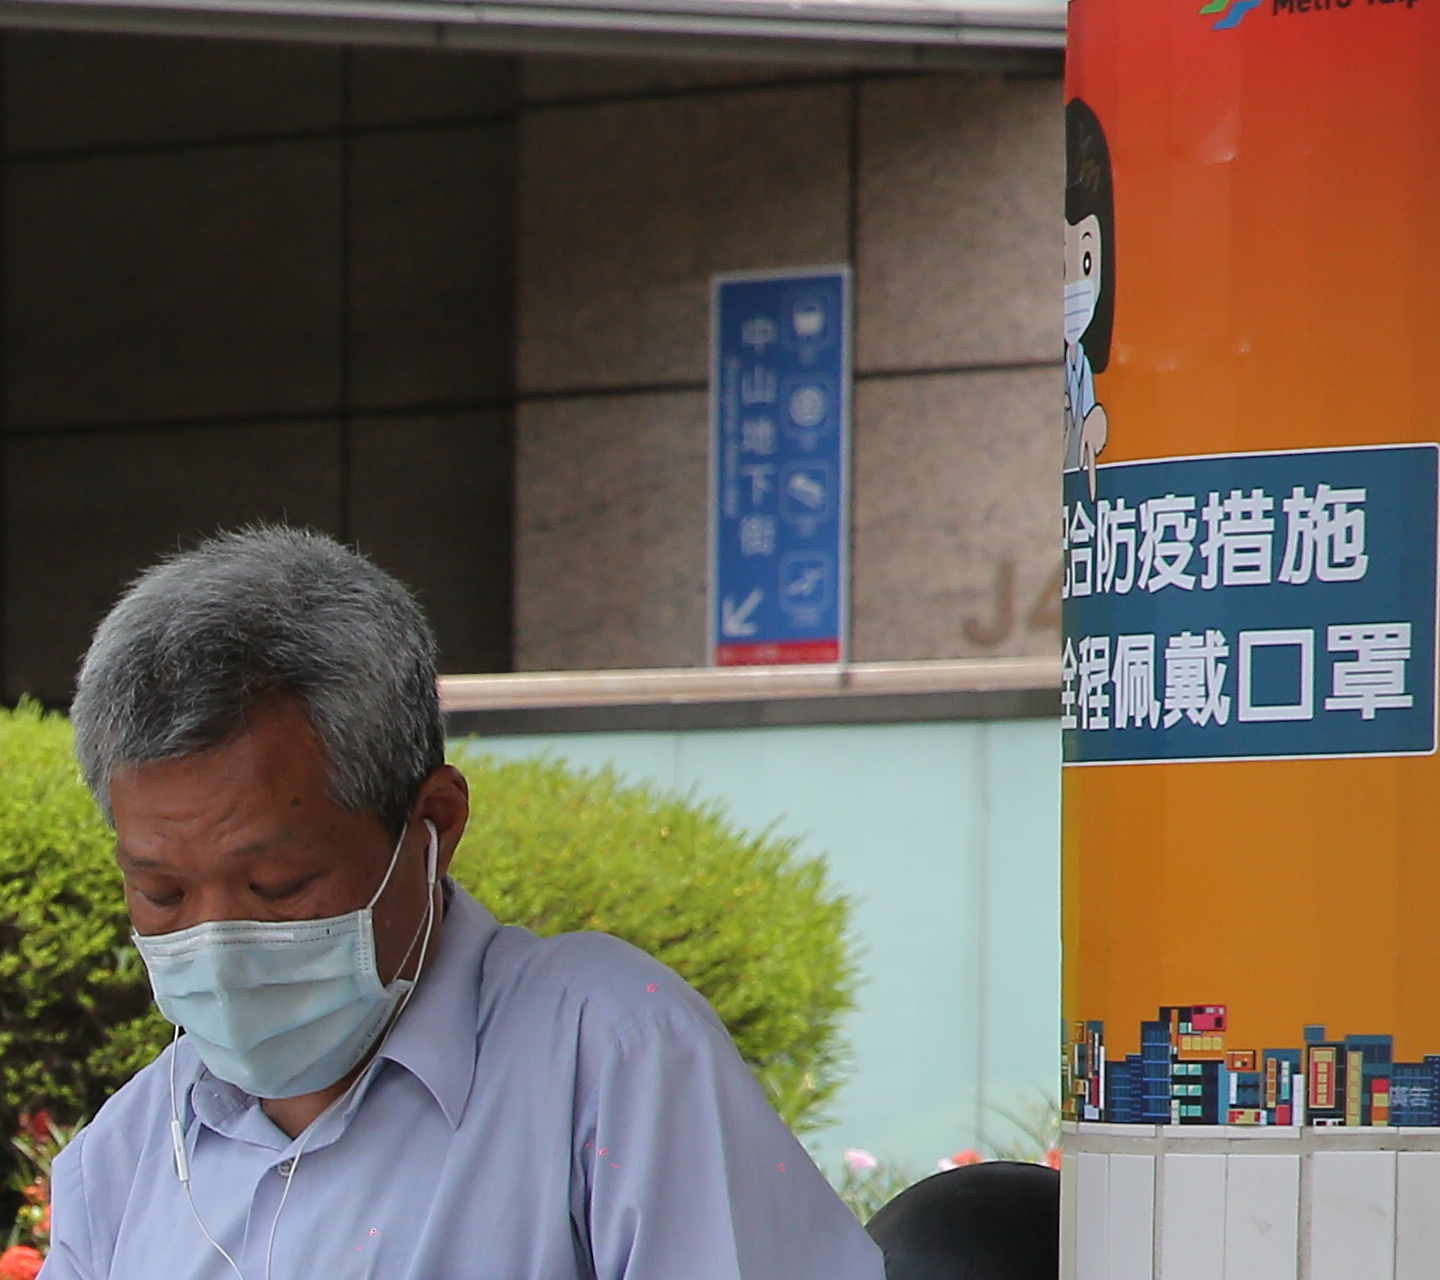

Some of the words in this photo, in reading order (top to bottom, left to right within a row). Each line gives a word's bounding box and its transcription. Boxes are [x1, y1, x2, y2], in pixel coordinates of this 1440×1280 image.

[1062, 621, 1414, 731] 全程佩戴口罩
